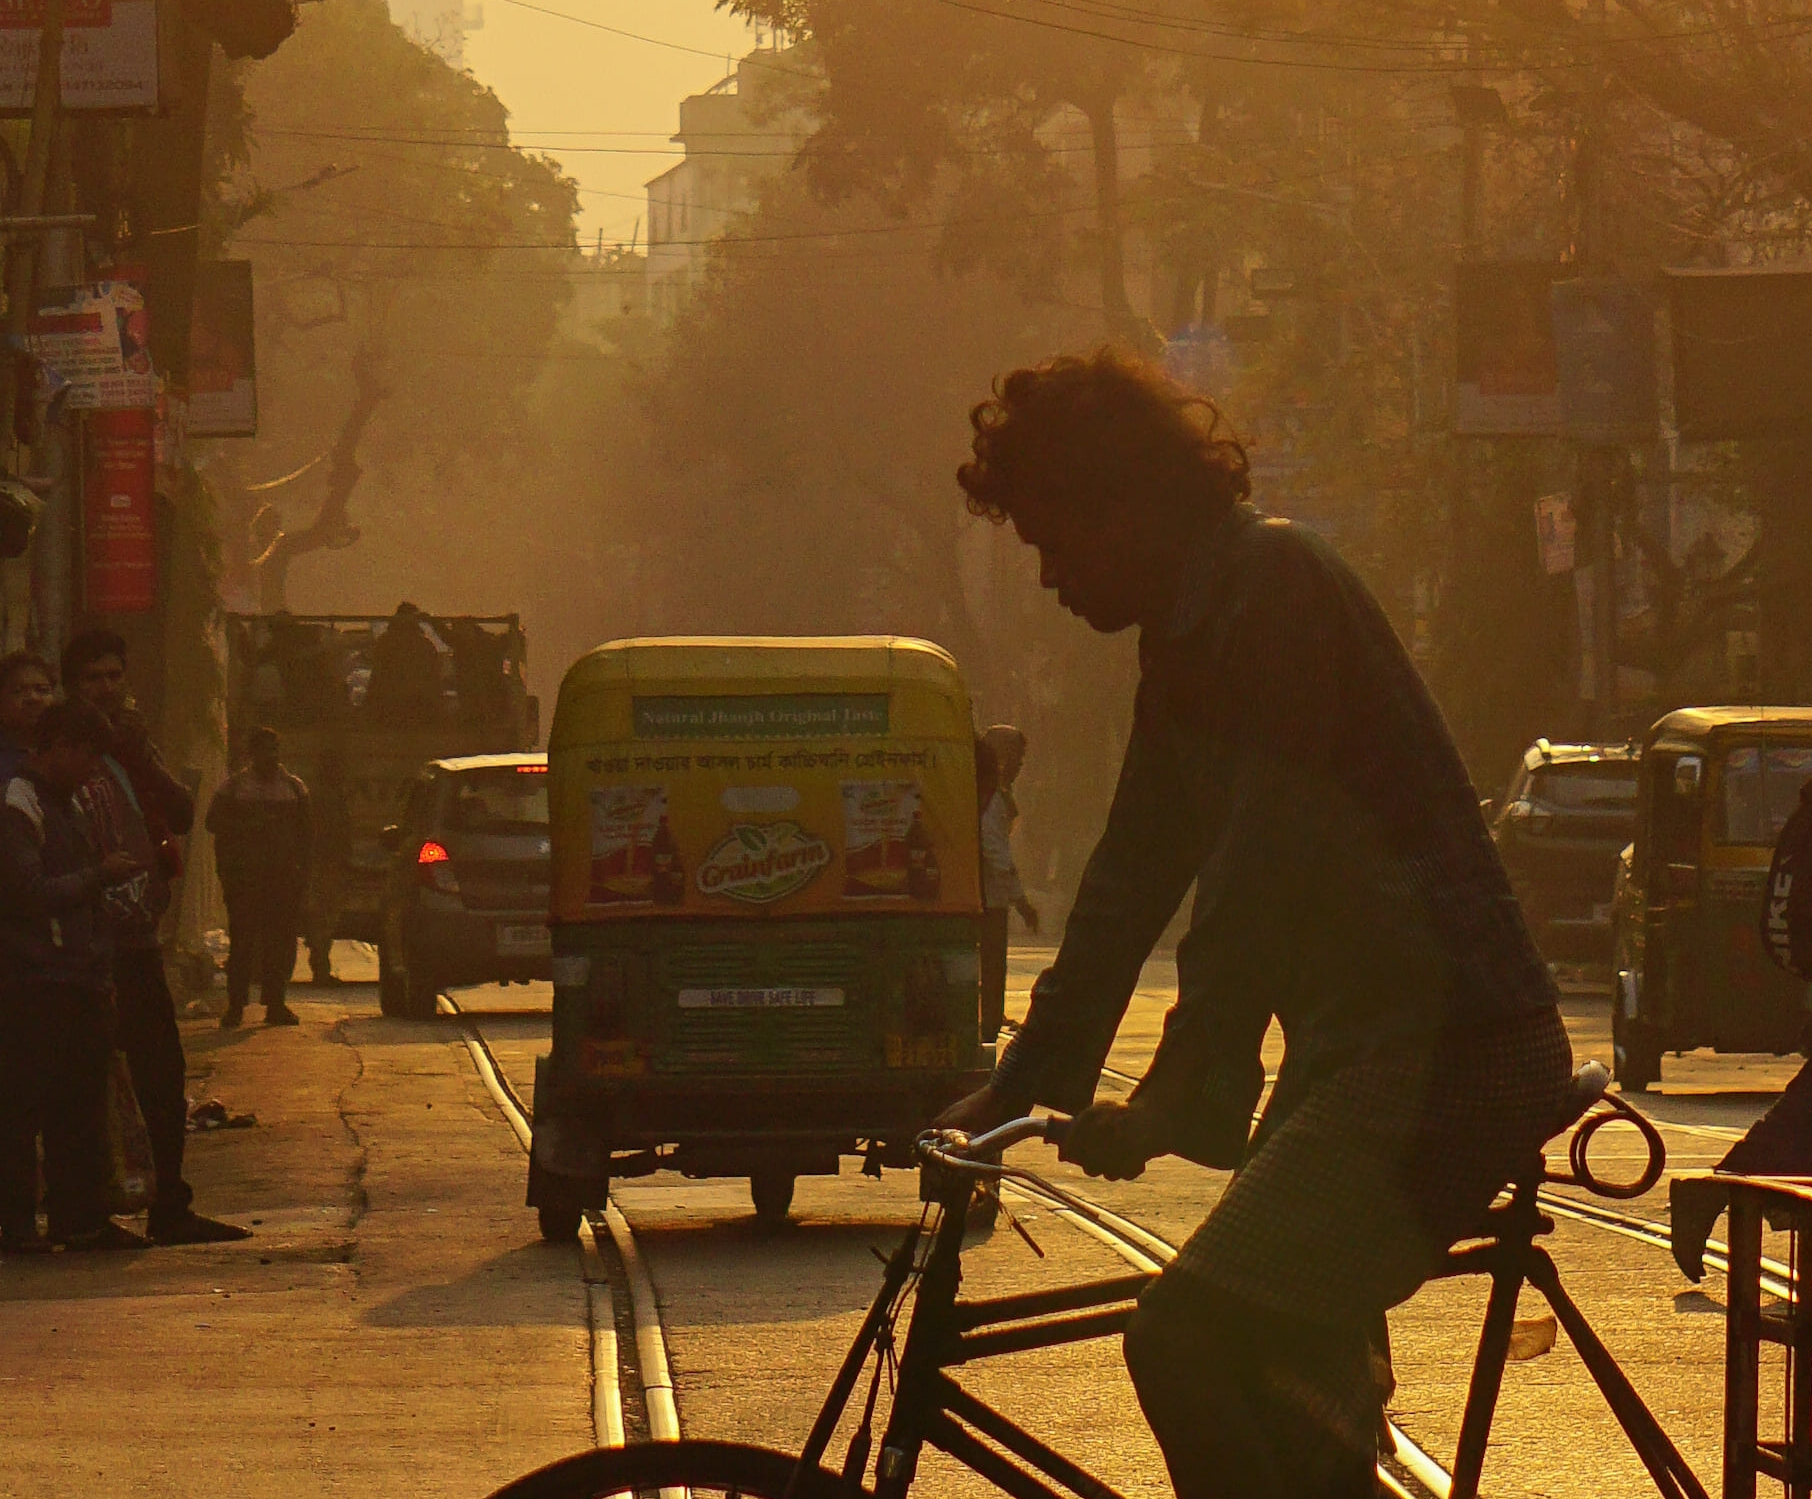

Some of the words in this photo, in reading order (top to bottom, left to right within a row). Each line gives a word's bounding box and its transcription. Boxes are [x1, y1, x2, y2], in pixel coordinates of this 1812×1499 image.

[642, 709, 704, 725] Natural
[768, 708, 837, 726] Original
[702, 842, 825, 888] Grainfarm
